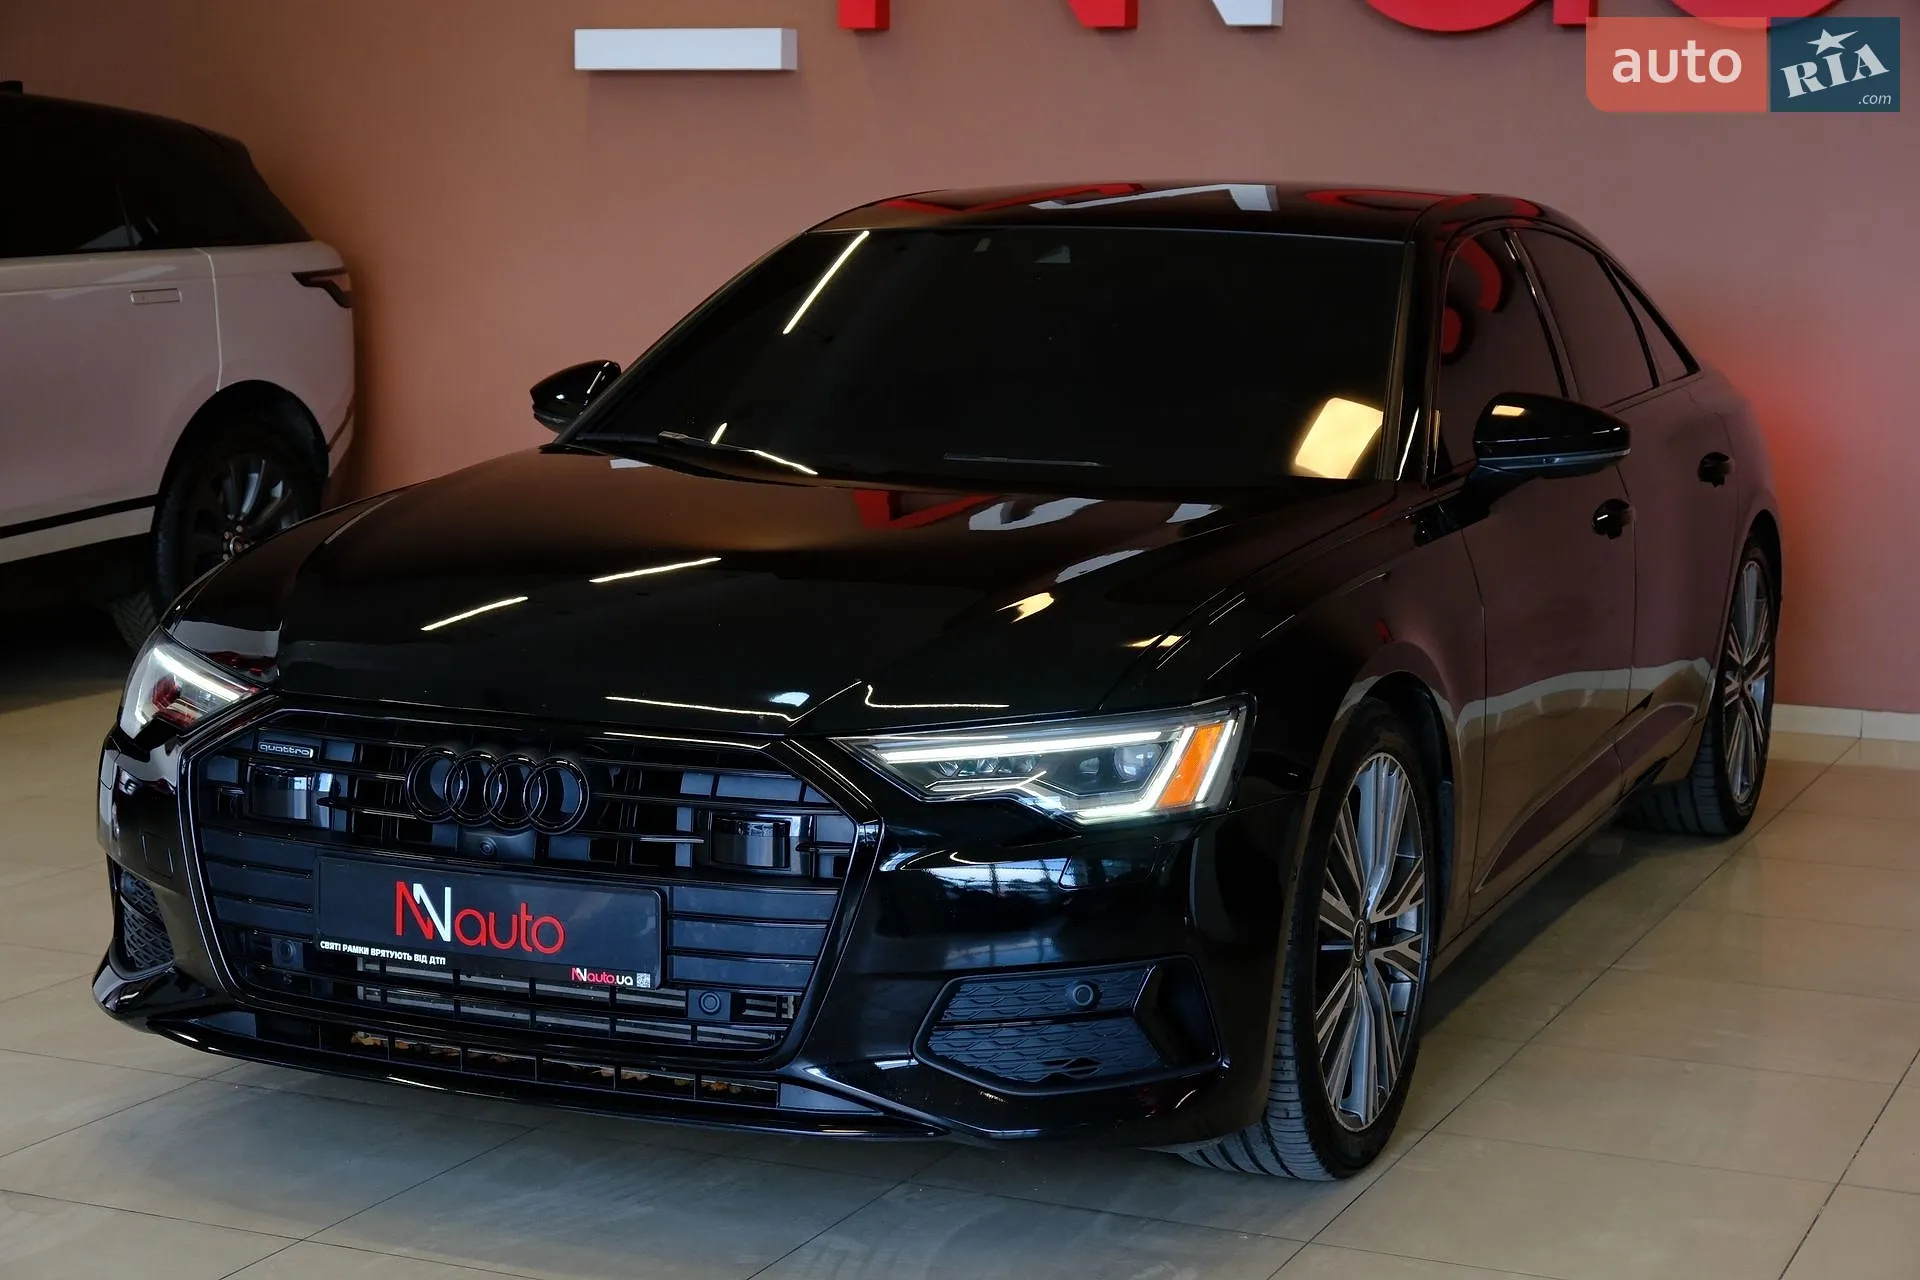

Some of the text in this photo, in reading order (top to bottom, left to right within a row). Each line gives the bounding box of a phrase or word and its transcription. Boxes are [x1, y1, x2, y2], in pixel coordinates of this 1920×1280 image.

[260, 744, 310, 755] quattro
[320, 941, 446, 965] СВЯТІ РАМКИ ВРЯТУЮТЬ ВІД ДТП
